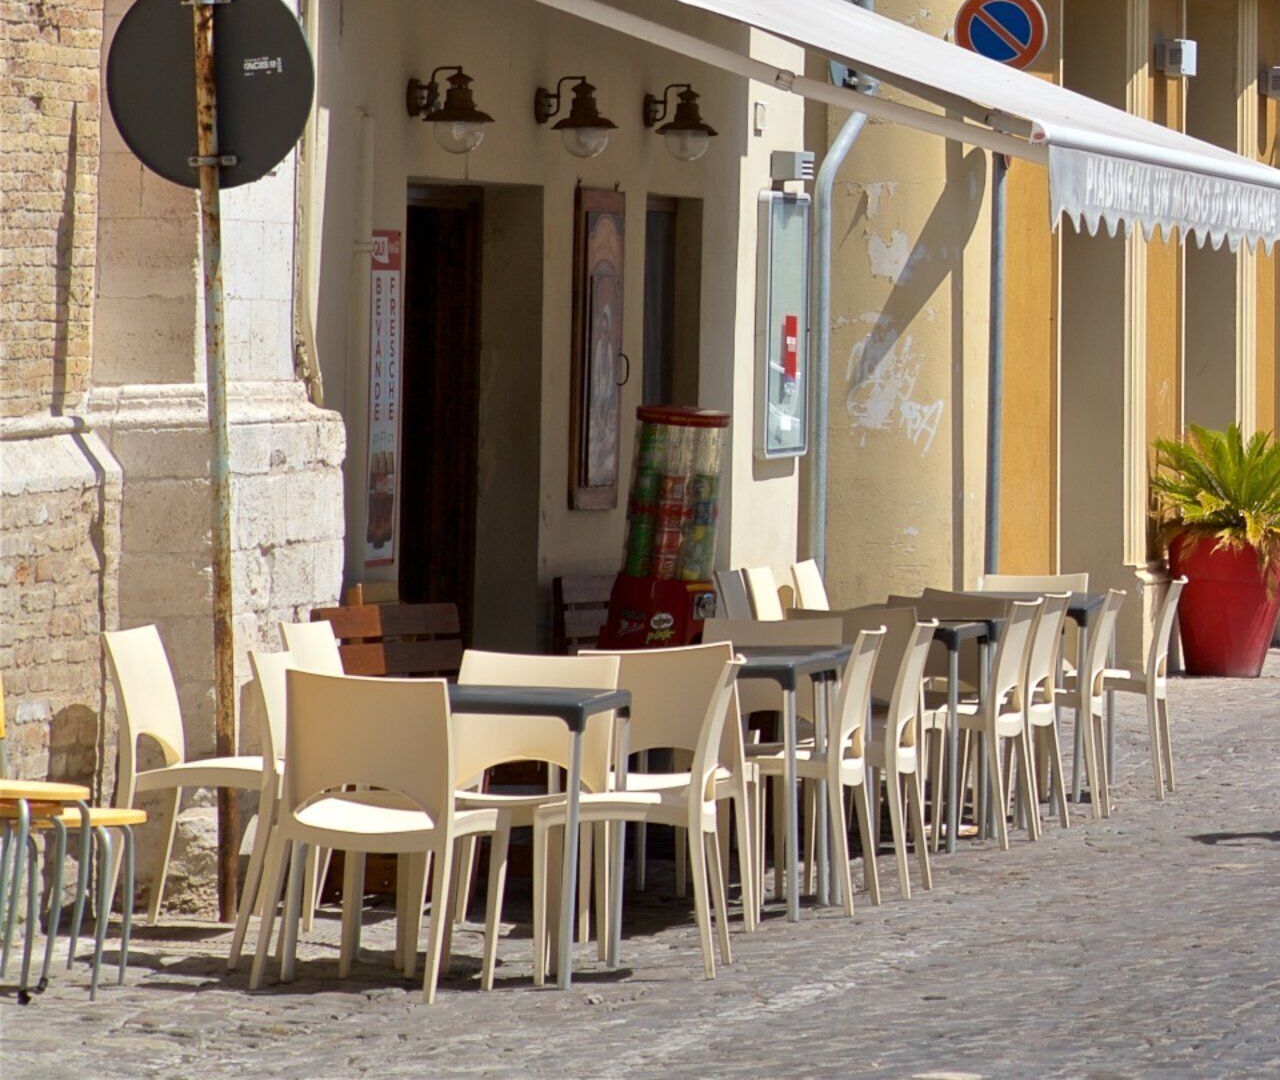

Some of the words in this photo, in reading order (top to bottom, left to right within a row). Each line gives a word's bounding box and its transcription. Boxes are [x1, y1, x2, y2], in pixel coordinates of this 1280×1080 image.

[1085, 157, 1151, 214] PIADINERIA
[1153, 171, 1171, 216] UN
[1171, 173, 1210, 224] MORSO
[1211, 182, 1225, 225] DI
[1226, 184, 1276, 233] ROMAGNA
[373, 277, 382, 422] BEVANDE
[388, 277, 396, 421] FRESCHE
